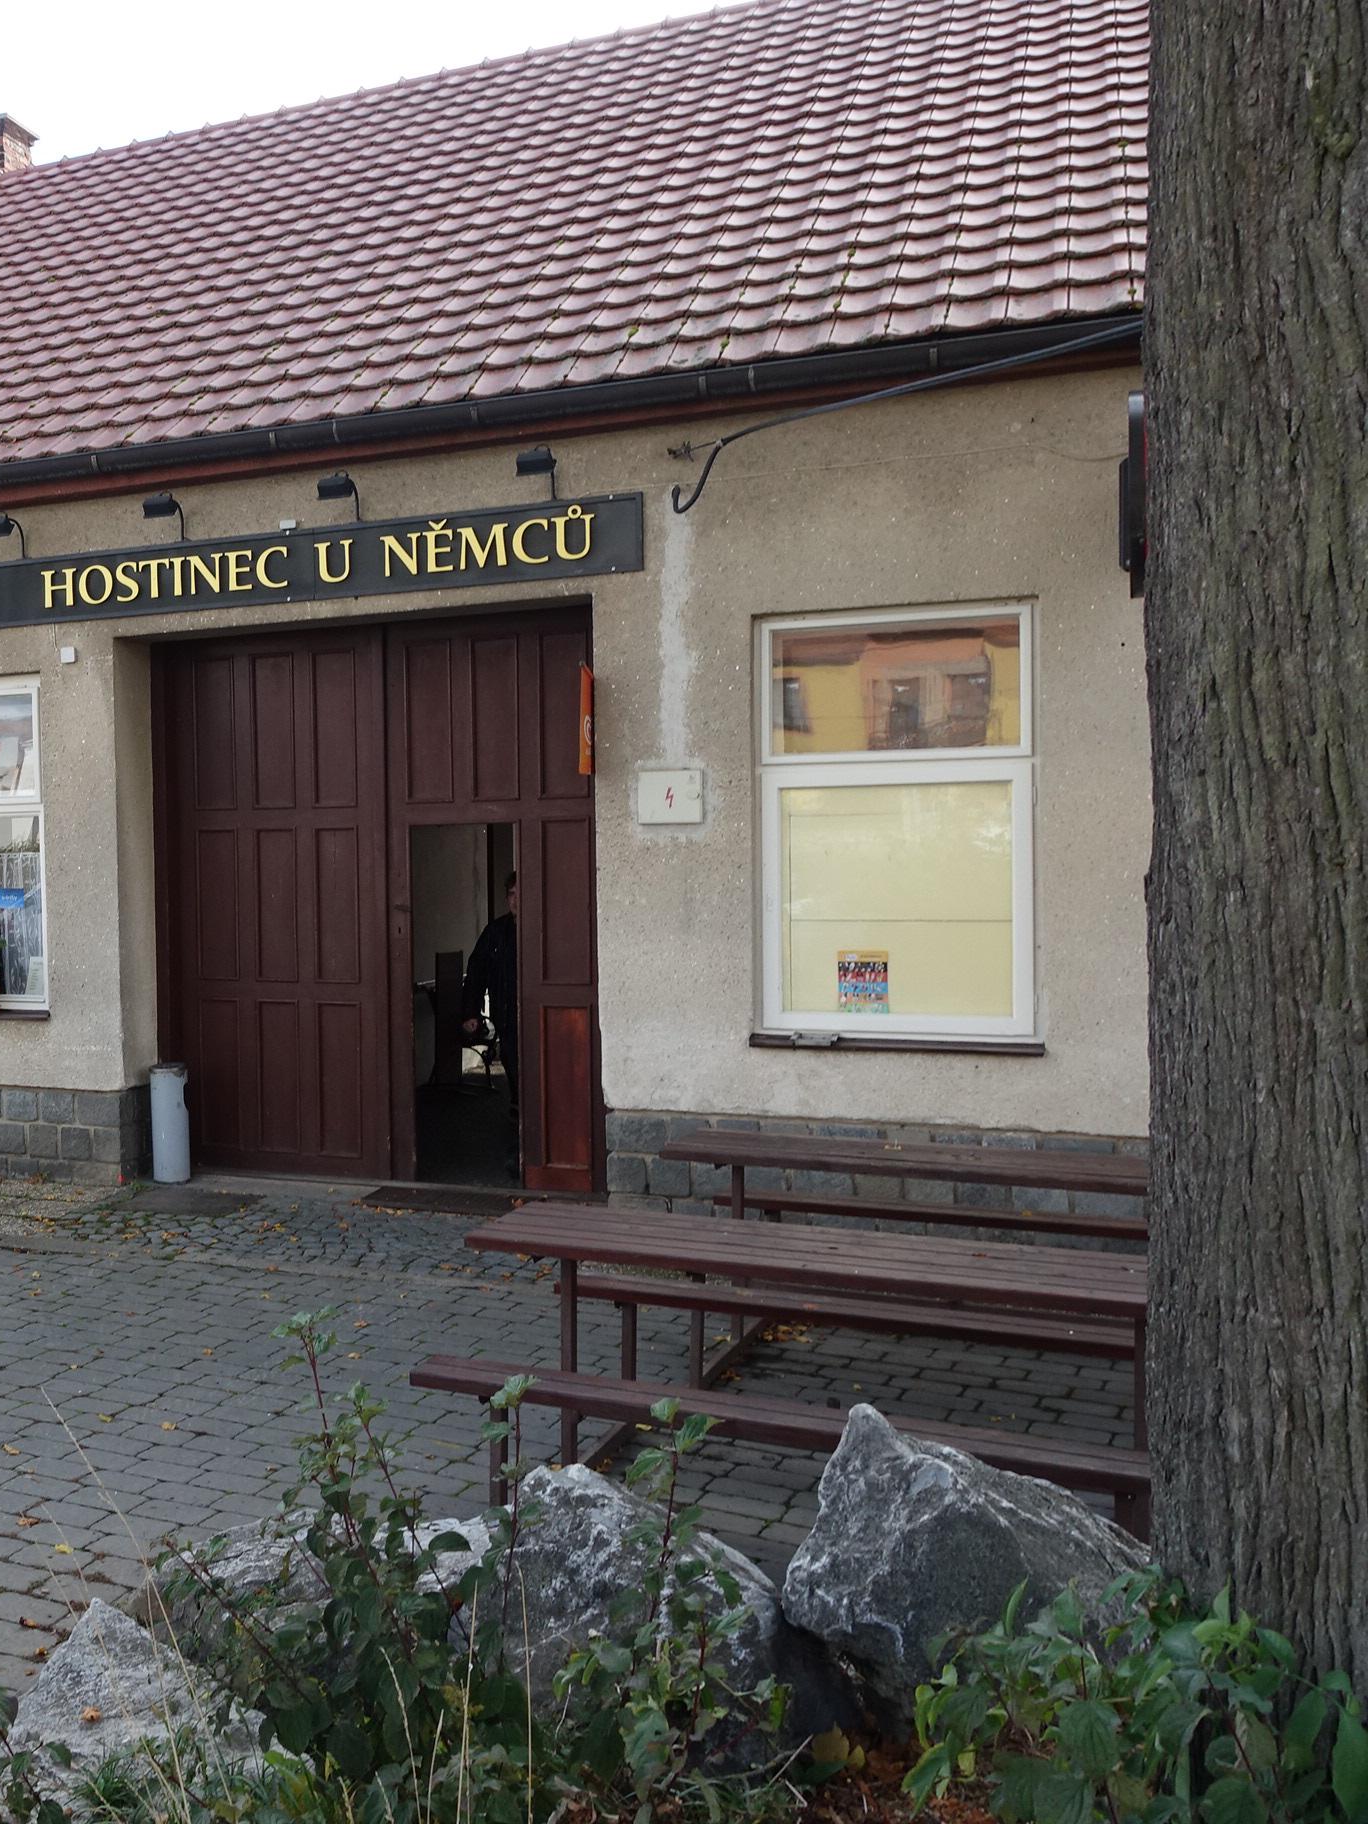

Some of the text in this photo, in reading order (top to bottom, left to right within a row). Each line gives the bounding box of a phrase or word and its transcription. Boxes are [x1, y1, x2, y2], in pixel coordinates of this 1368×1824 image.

[40, 504, 595, 609] HOSTINEC U NĚMCŮ
